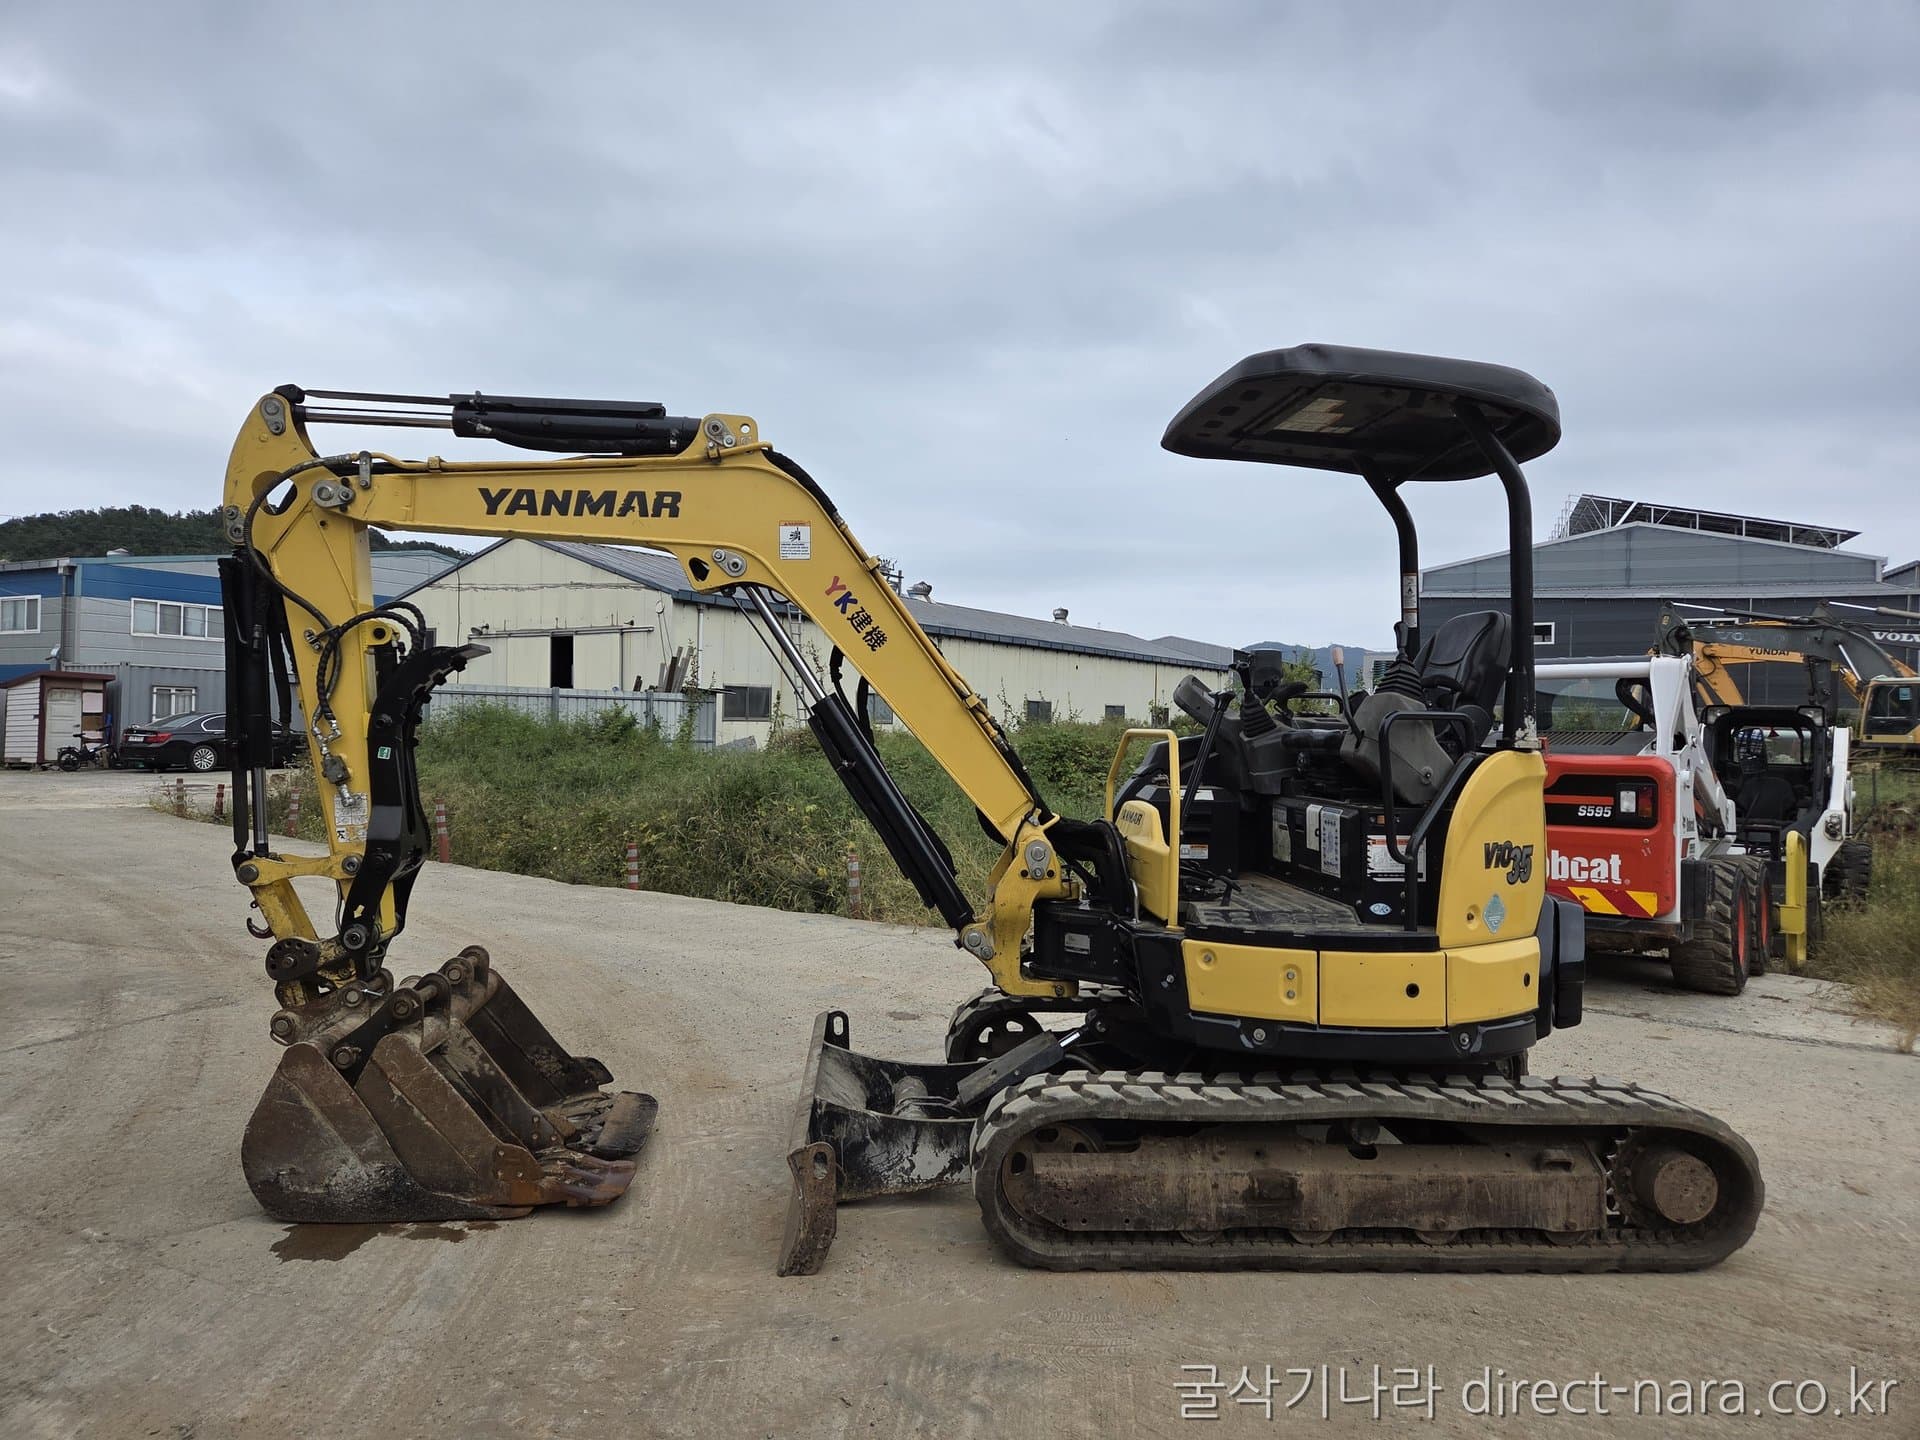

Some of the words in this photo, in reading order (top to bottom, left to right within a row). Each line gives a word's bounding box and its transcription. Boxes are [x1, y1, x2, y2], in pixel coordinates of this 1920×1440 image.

[478, 488, 682, 518] YANMAR
[1577, 806, 1613, 818] S595
[1546, 850, 1622, 885] bcat
